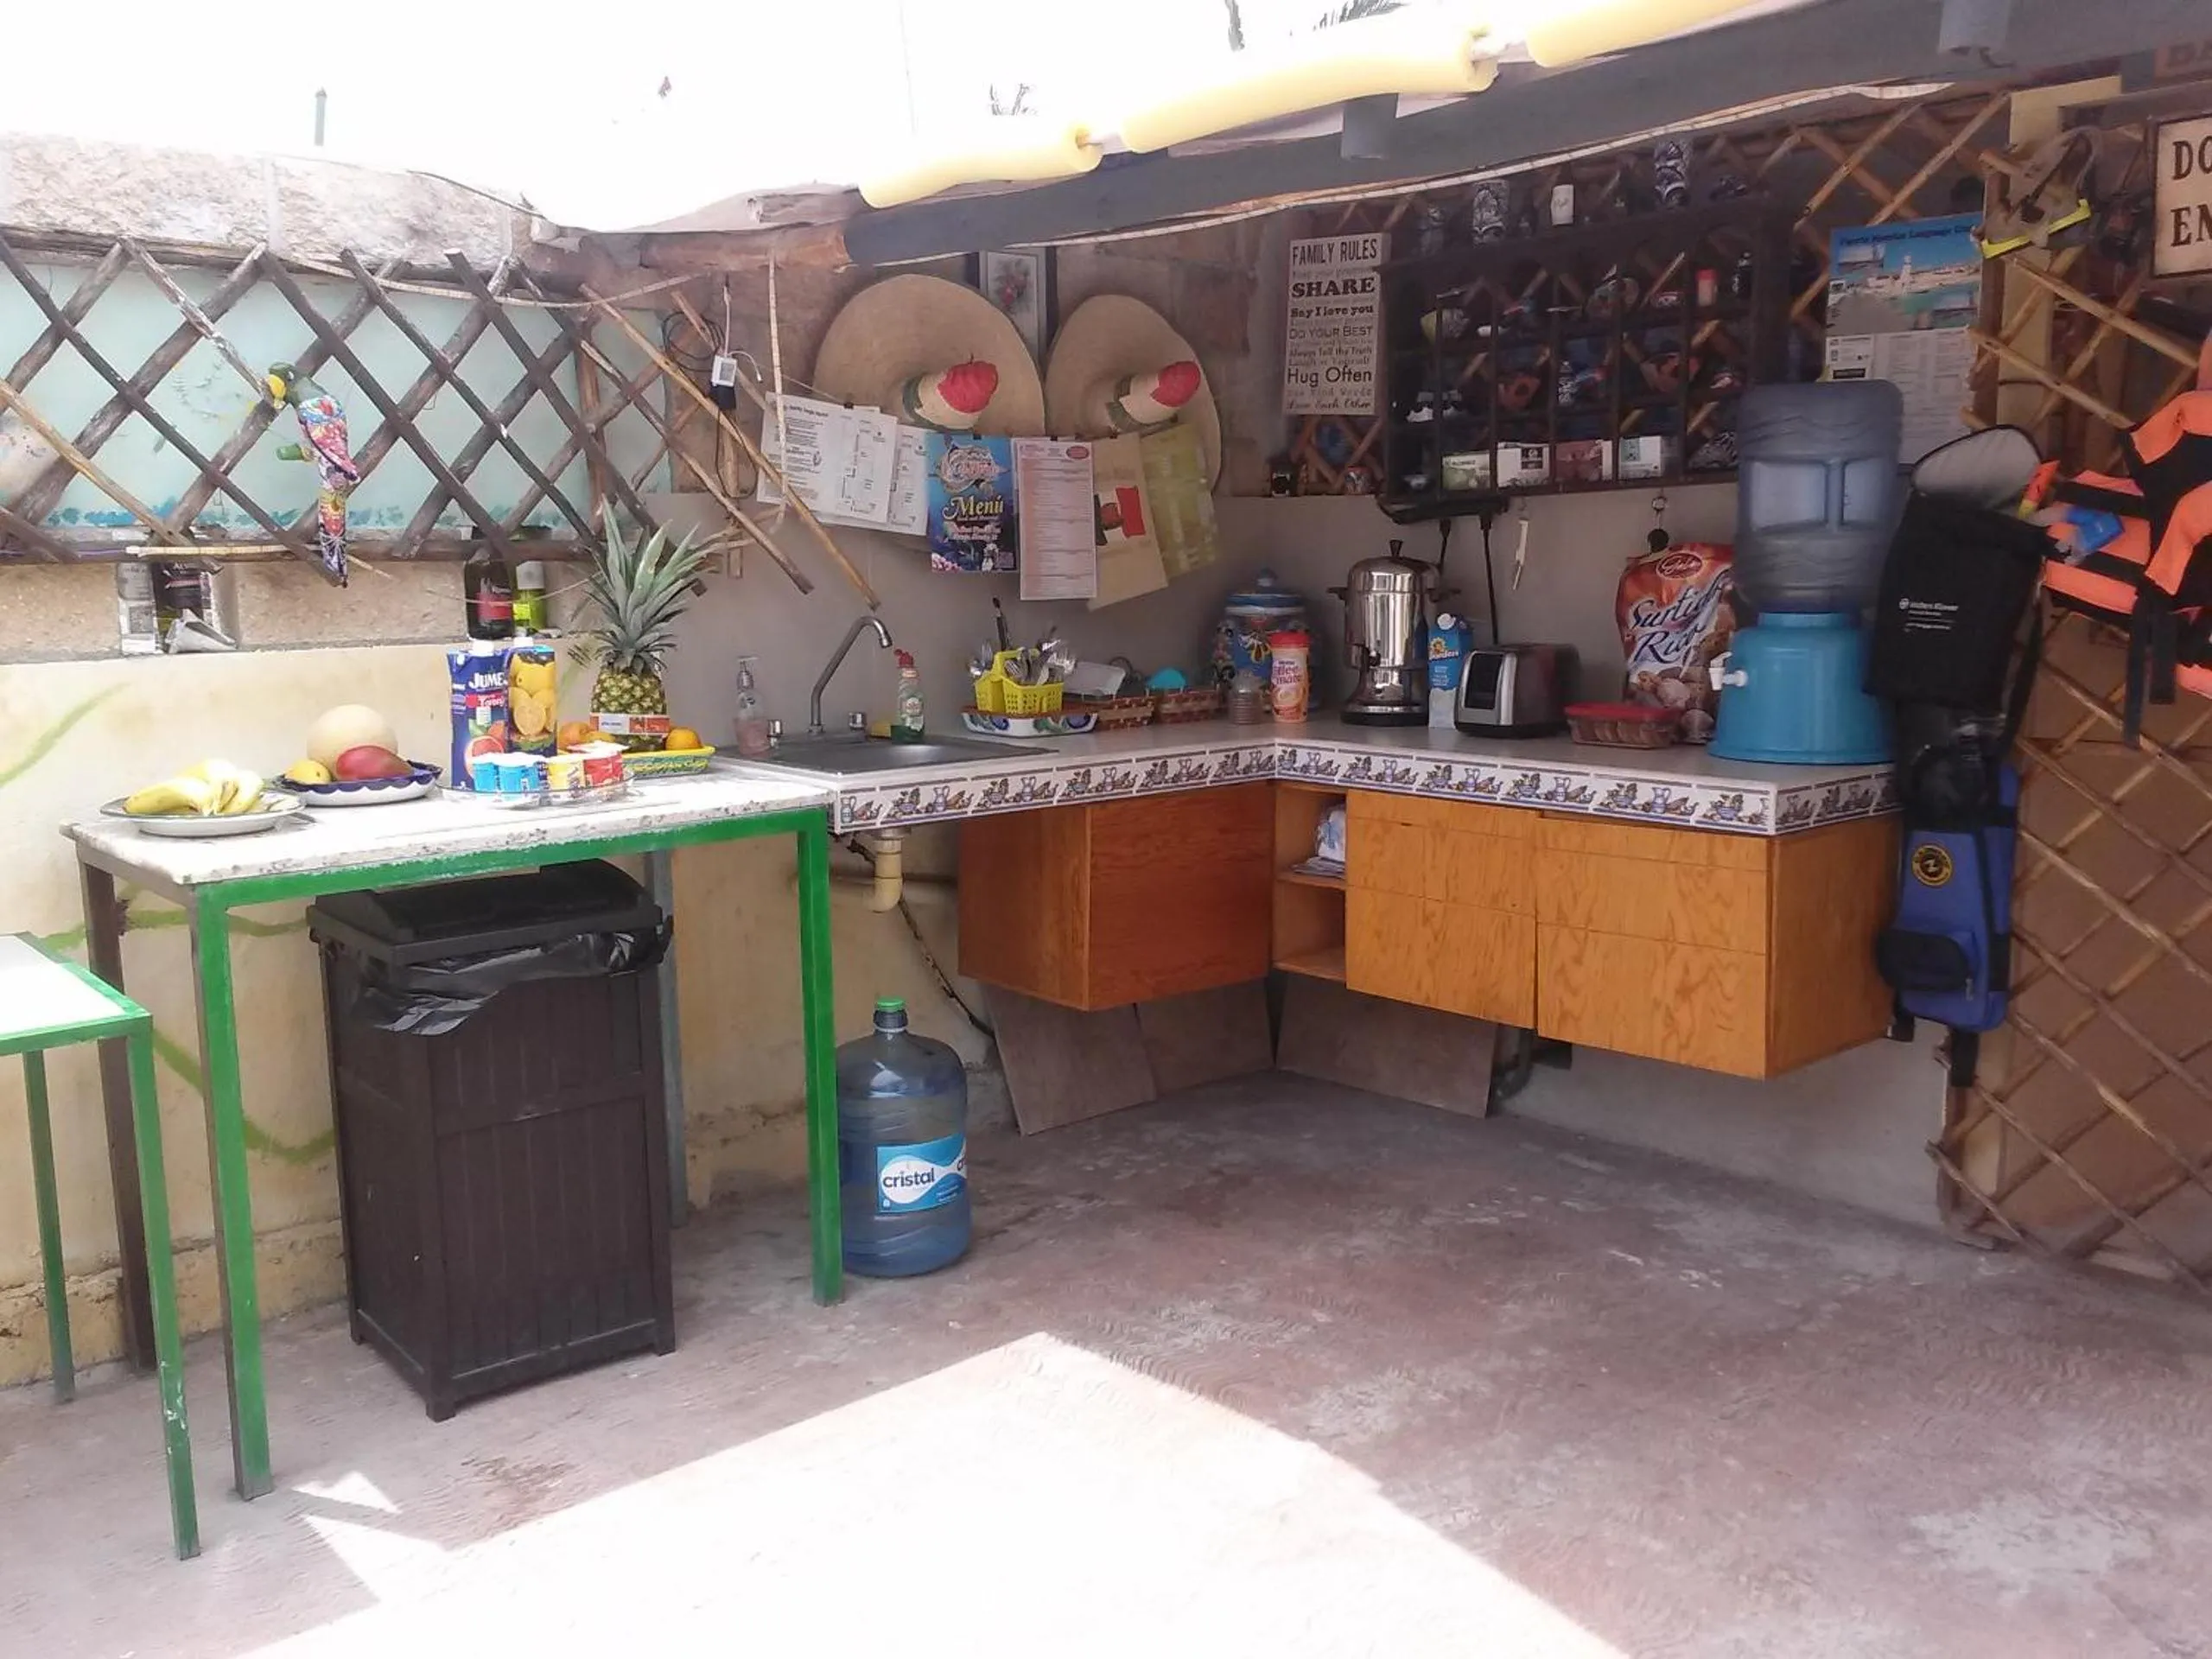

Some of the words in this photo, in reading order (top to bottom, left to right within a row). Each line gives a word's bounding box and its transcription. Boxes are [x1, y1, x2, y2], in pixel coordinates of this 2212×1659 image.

[1292, 242, 1335, 266] FAMILY
[1340, 238, 1377, 261] RULES
[1291, 276, 1376, 298] SHARE
[1315, 306, 1322, 317] I
[1323, 306, 1348, 317] love
[1350, 304, 1374, 317] you
[1342, 325, 1373, 338] BEST
[1287, 367, 1319, 387] Hug
[1325, 364, 1372, 382] Often
[942, 494, 1004, 520] Menú
[467, 671, 509, 690] JUME
[882, 1167, 935, 1188] cristal
